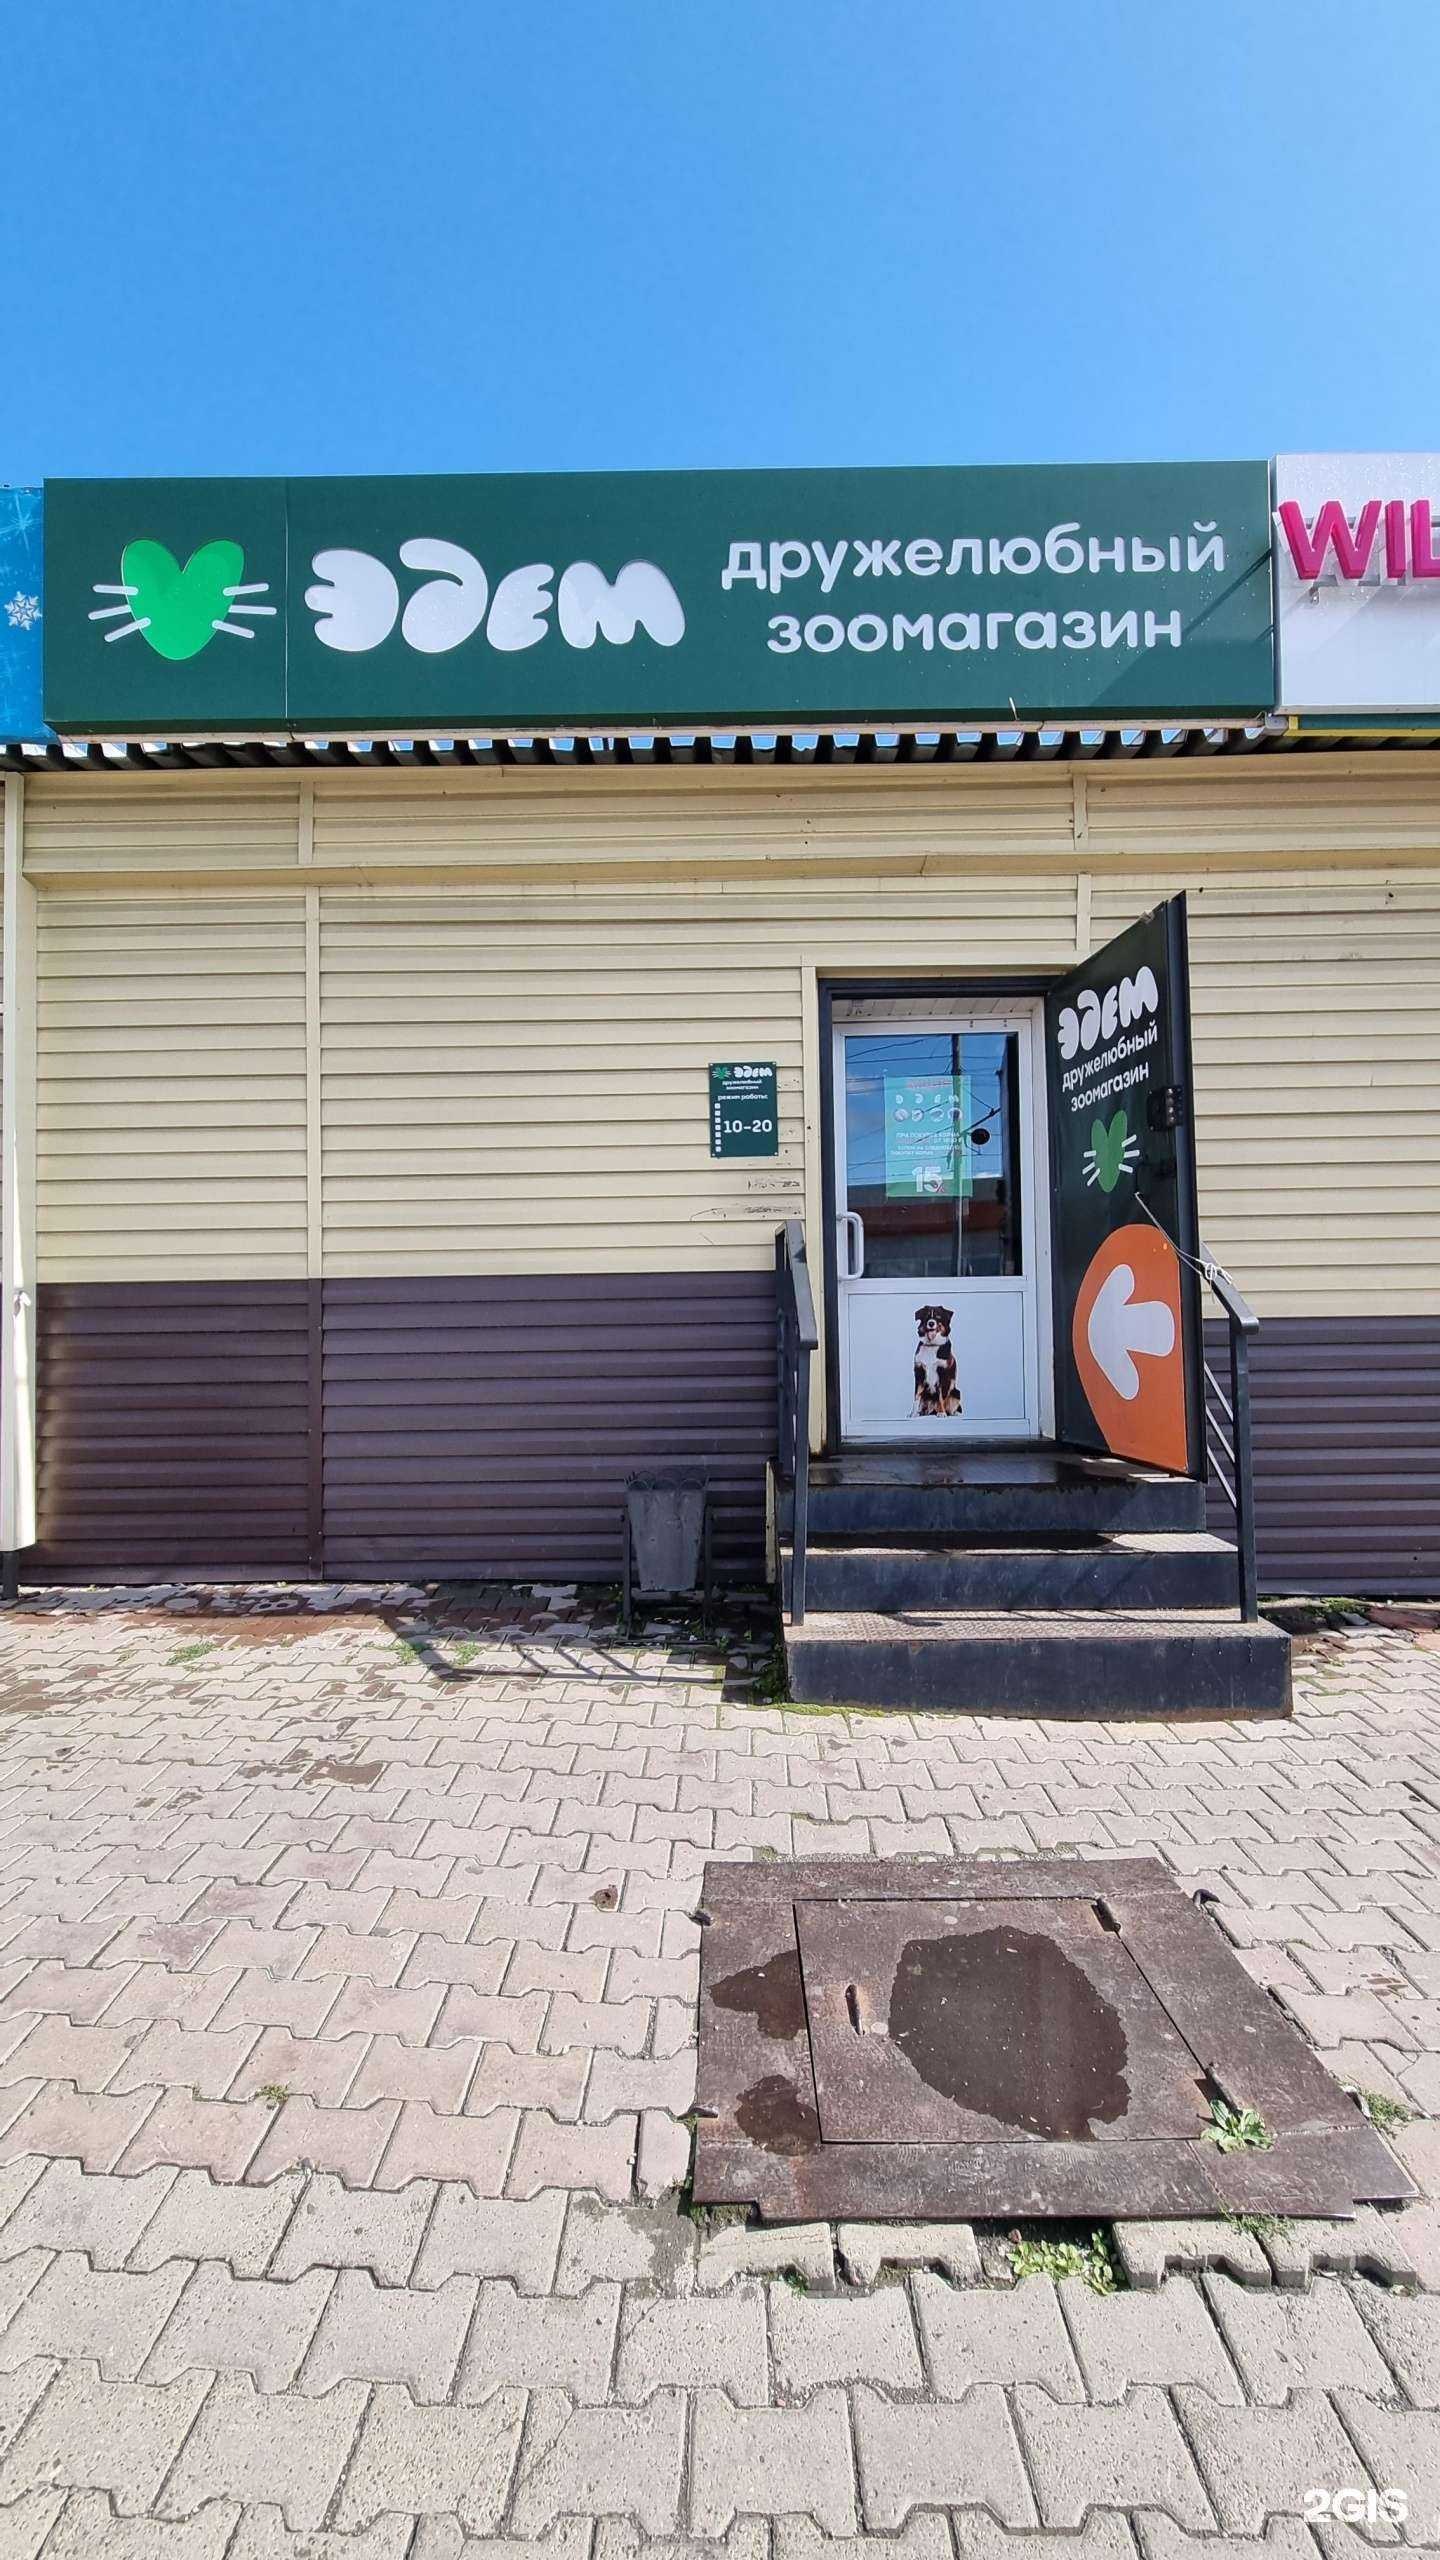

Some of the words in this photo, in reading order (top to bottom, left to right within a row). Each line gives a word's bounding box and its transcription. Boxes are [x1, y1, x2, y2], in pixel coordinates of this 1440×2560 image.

[721, 521, 1225, 594] дружелюбный
[767, 608, 1183, 654] зоомагазин
[1061, 1020, 1159, 1092] дружелюбный
[1070, 1061, 1149, 1112] зоомагазин
